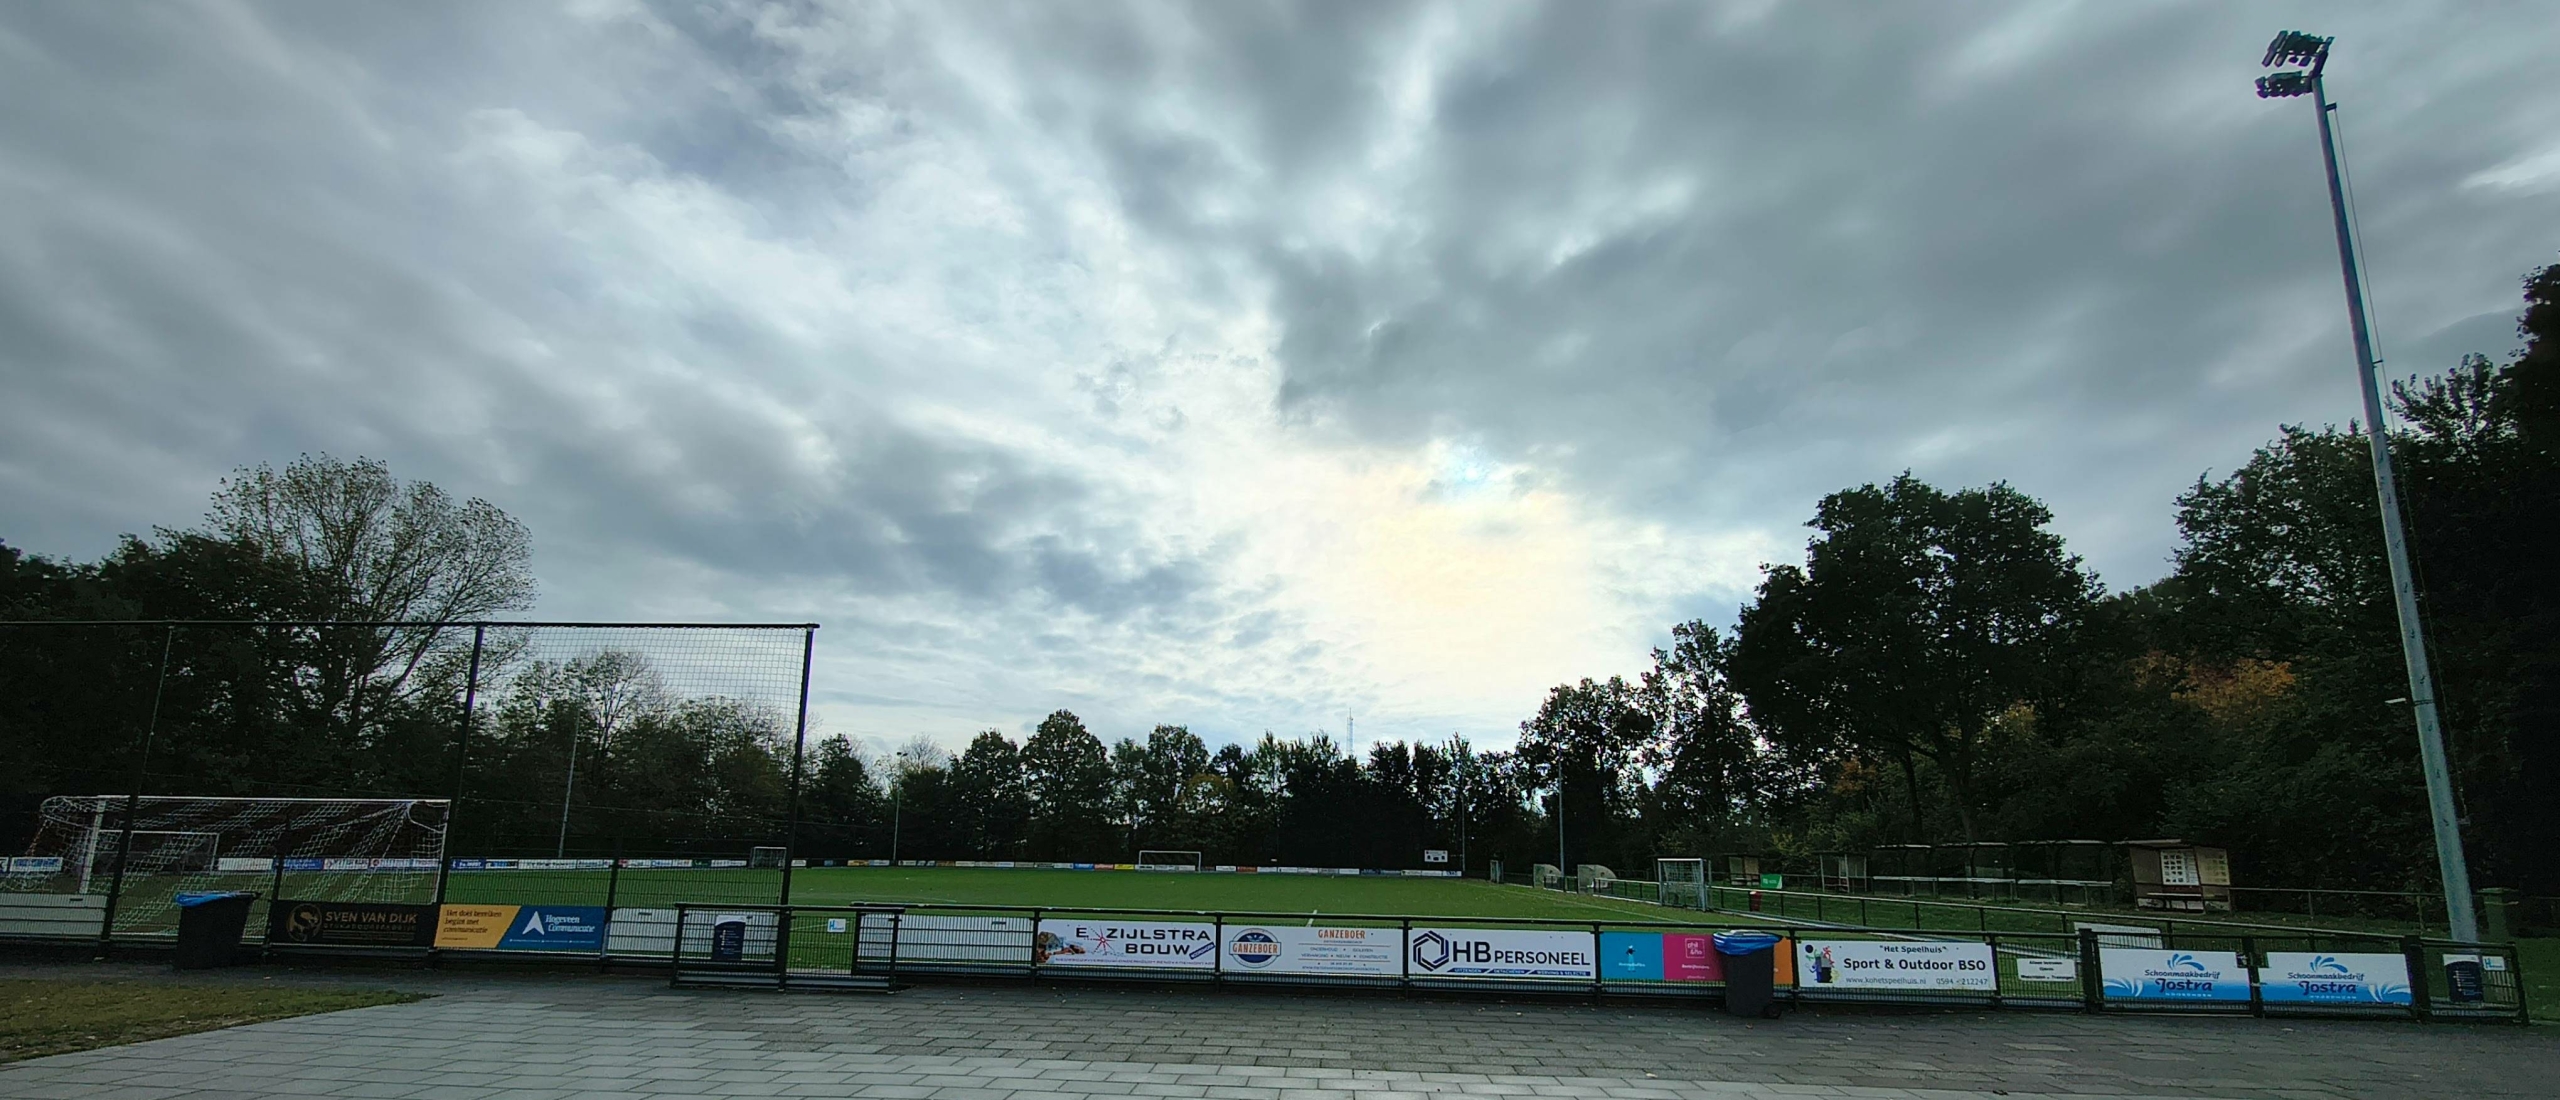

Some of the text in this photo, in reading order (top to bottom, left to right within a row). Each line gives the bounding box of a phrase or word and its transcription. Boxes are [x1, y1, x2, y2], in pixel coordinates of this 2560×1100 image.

[325, 911, 418, 924] SVEN VAN DIJK
[545, 914, 580, 924] Hogeveen
[548, 923, 595, 932] Communicatie
[1106, 928, 1211, 941] ZIJLSTRA
[1318, 929, 1365, 939] GANZEBOER
[1126, 944, 1190, 955] BOUW
[1232, 943, 1278, 954] GANZEBOER
[1453, 941, 1590, 966] HB PERSONEEL
[1844, 958, 1986, 971] Sport & Outdoor BSO
[2144, 969, 2220, 979] Schoonmaakbedrijf
[2288, 972, 2365, 981] Schoonmaakbedrijf
[1846, 976, 1926, 985] www.kohetspeelhuis.nl
[1961, 978, 1988, 986] 212247
[2155, 978, 2212, 993] Jostra
[2298, 980, 2358, 996] Jostra
